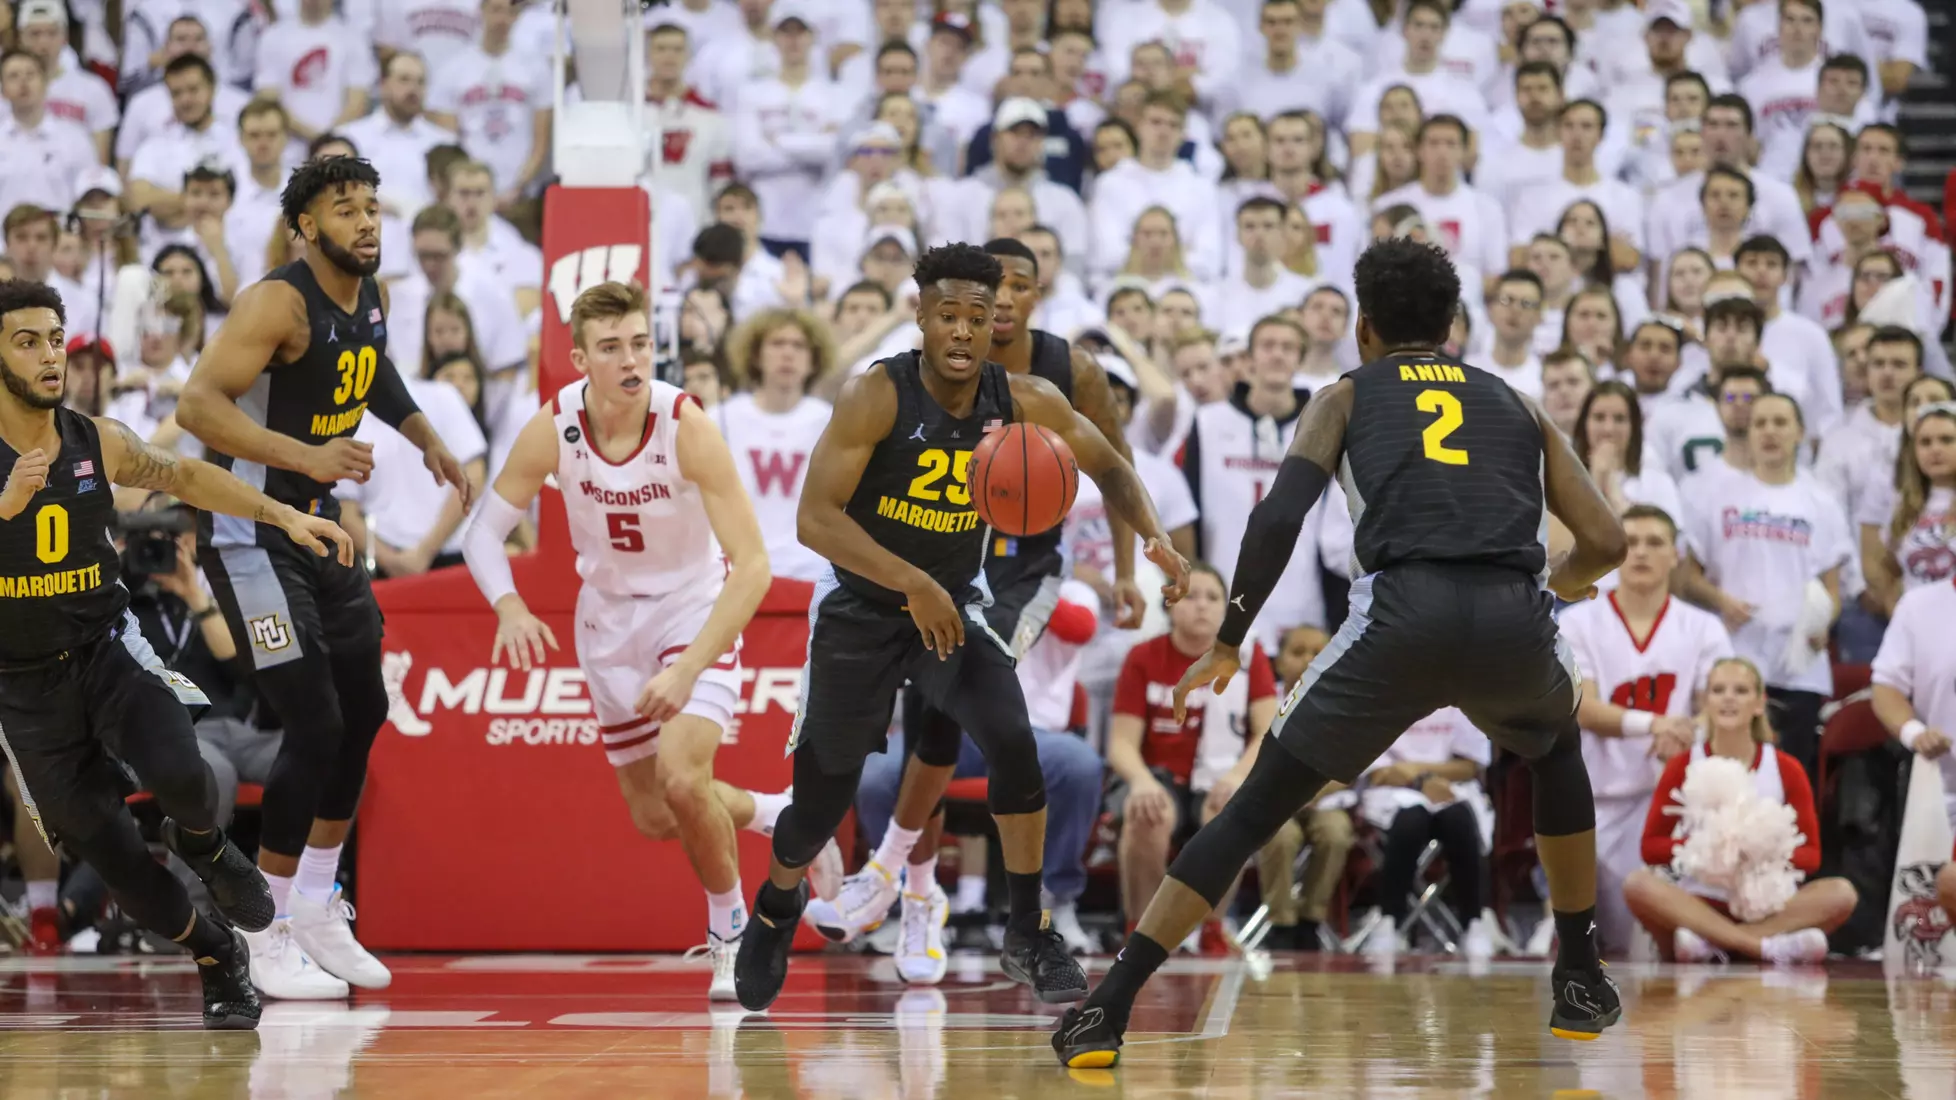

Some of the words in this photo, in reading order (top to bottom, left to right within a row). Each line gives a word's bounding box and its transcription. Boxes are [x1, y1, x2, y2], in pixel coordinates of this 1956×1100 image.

[333, 345, 377, 405] 30
[1398, 364, 1467, 383] ANIM
[1415, 388, 1469, 466] 2
[748, 449, 806, 498] W
[907, 448, 973, 506] 25
[36, 503, 69, 564] 0
[605, 512, 646, 553] 5
[876, 495, 979, 533] MARQUETTE
[0, 562, 102, 599] MARQUETTE
[250, 614, 291, 651] MU
[485, 718, 601, 746] SPORTS
